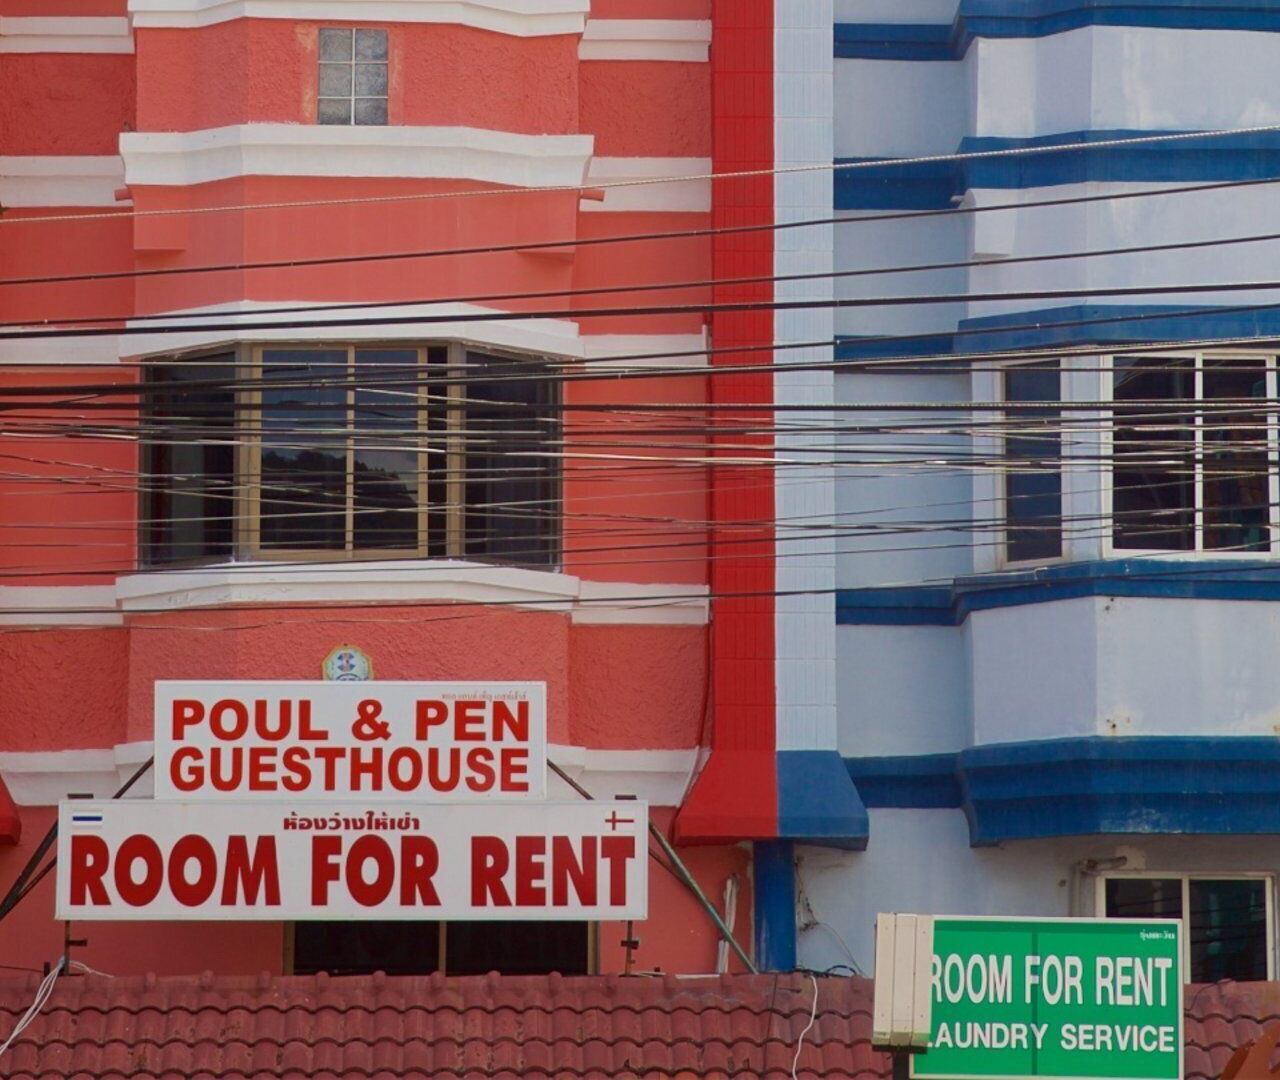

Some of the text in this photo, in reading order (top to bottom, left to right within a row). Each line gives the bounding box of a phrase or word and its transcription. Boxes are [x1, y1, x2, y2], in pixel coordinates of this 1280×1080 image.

[171, 699, 529, 742] POUL & PEN
[170, 746, 529, 792] GUESTHOUSE
[282, 810, 421, 831] ห้องว่างให้เช่า
[70, 835, 635, 907] ROOM FOR RENT
[930, 954, 1173, 1006] ROOM FOR RENT
[928, 1022, 1174, 1052] AUNDRY SERVICE
